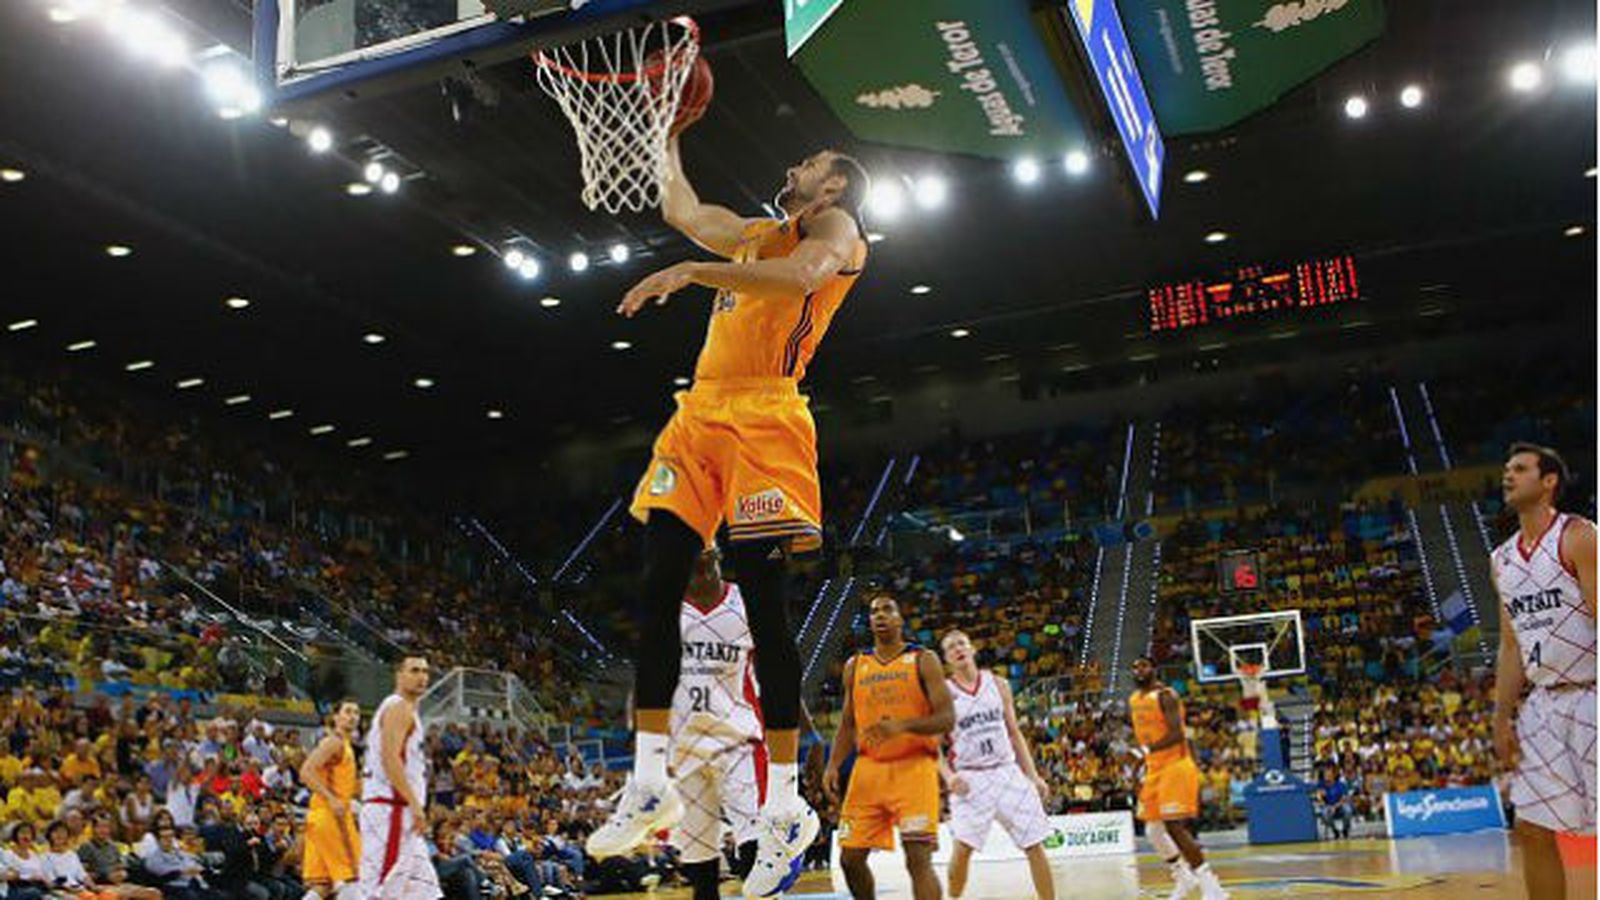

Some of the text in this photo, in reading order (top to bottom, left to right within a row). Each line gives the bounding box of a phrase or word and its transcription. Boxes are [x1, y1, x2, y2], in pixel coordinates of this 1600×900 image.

[935, 21, 984, 73] Teror
[1197, 28, 1232, 52] de
[959, 67, 997, 95] de
